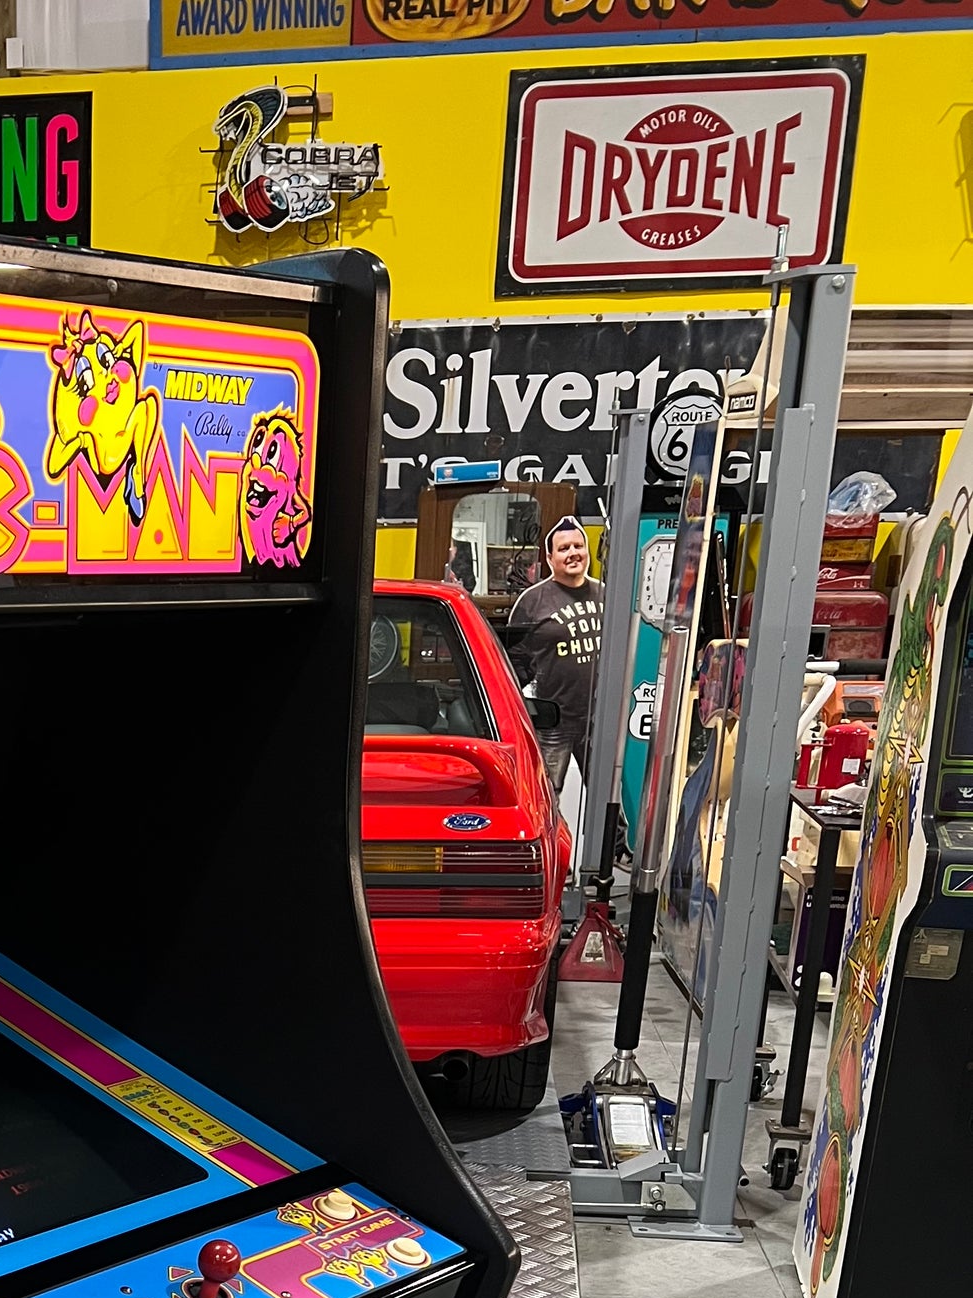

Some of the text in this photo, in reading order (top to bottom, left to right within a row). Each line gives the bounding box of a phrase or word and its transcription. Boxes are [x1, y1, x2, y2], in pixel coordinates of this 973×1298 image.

[176, 0, 345, 37] AWARD WINNING
[383, 0, 456, 20] REAL
[639, 109, 720, 138] MOTOR OILS
[260, 144, 381, 166] COBRA
[556, 112, 802, 241] DRYDENE
[642, 224, 701, 246] GREASES
[153, 360, 163, 372] by
[164, 368, 254, 406] MIDWAY
[383, 348, 749, 440] Silvert
[730, 395, 755, 410] namco
[194, 411, 233, 444] Bally
[672, 411, 713, 422] ROUTE
[453, 815, 479, 827] Ford
[318, 1217, 396, 1251] START GAME
